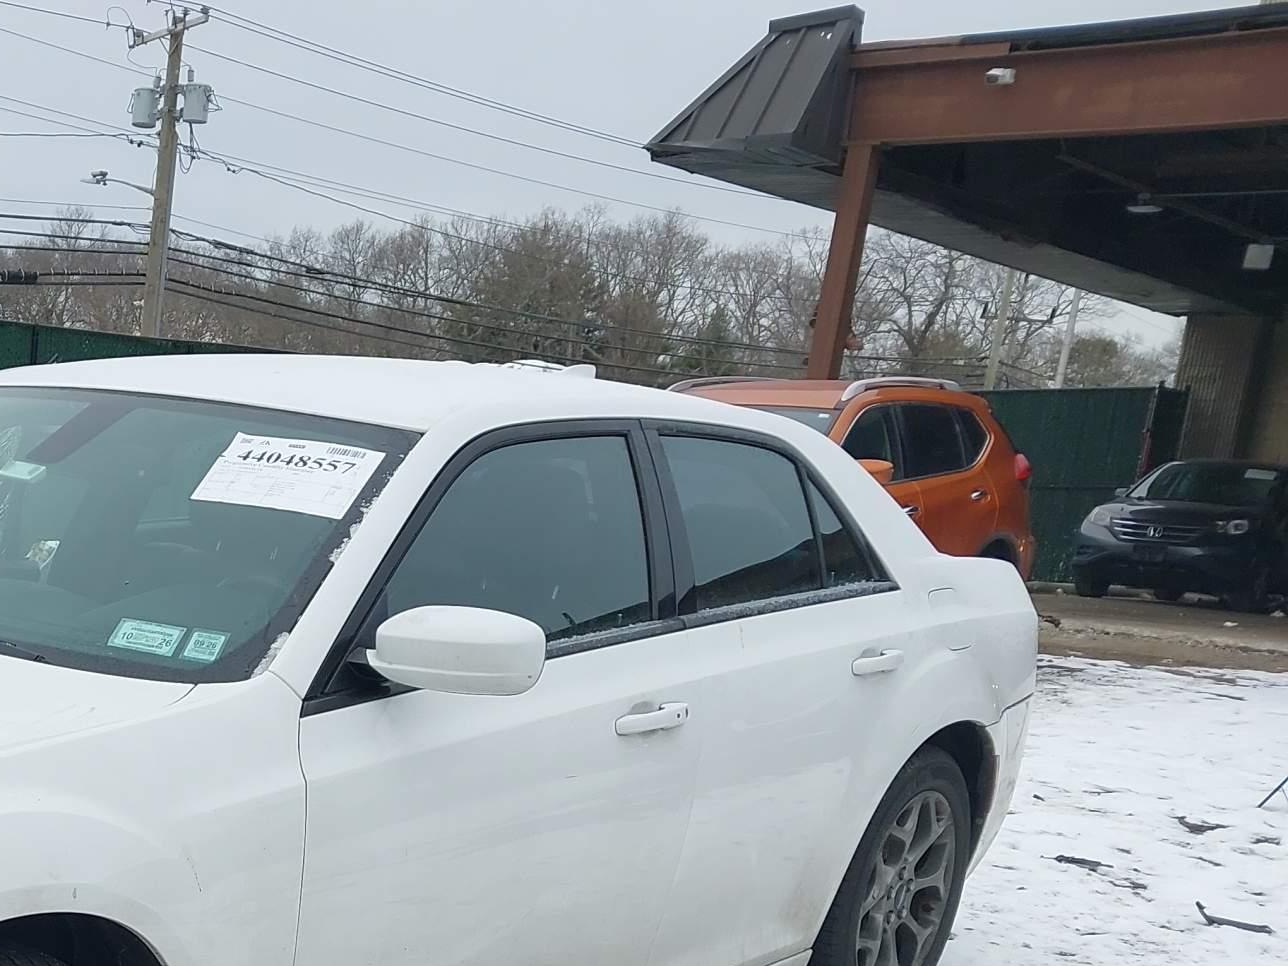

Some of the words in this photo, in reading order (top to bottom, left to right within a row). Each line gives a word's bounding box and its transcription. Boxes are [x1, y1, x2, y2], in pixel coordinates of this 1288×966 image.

[237, 449, 356, 474] 44048557
[120, 631, 134, 641] 10
[159, 638, 173, 648] 26
